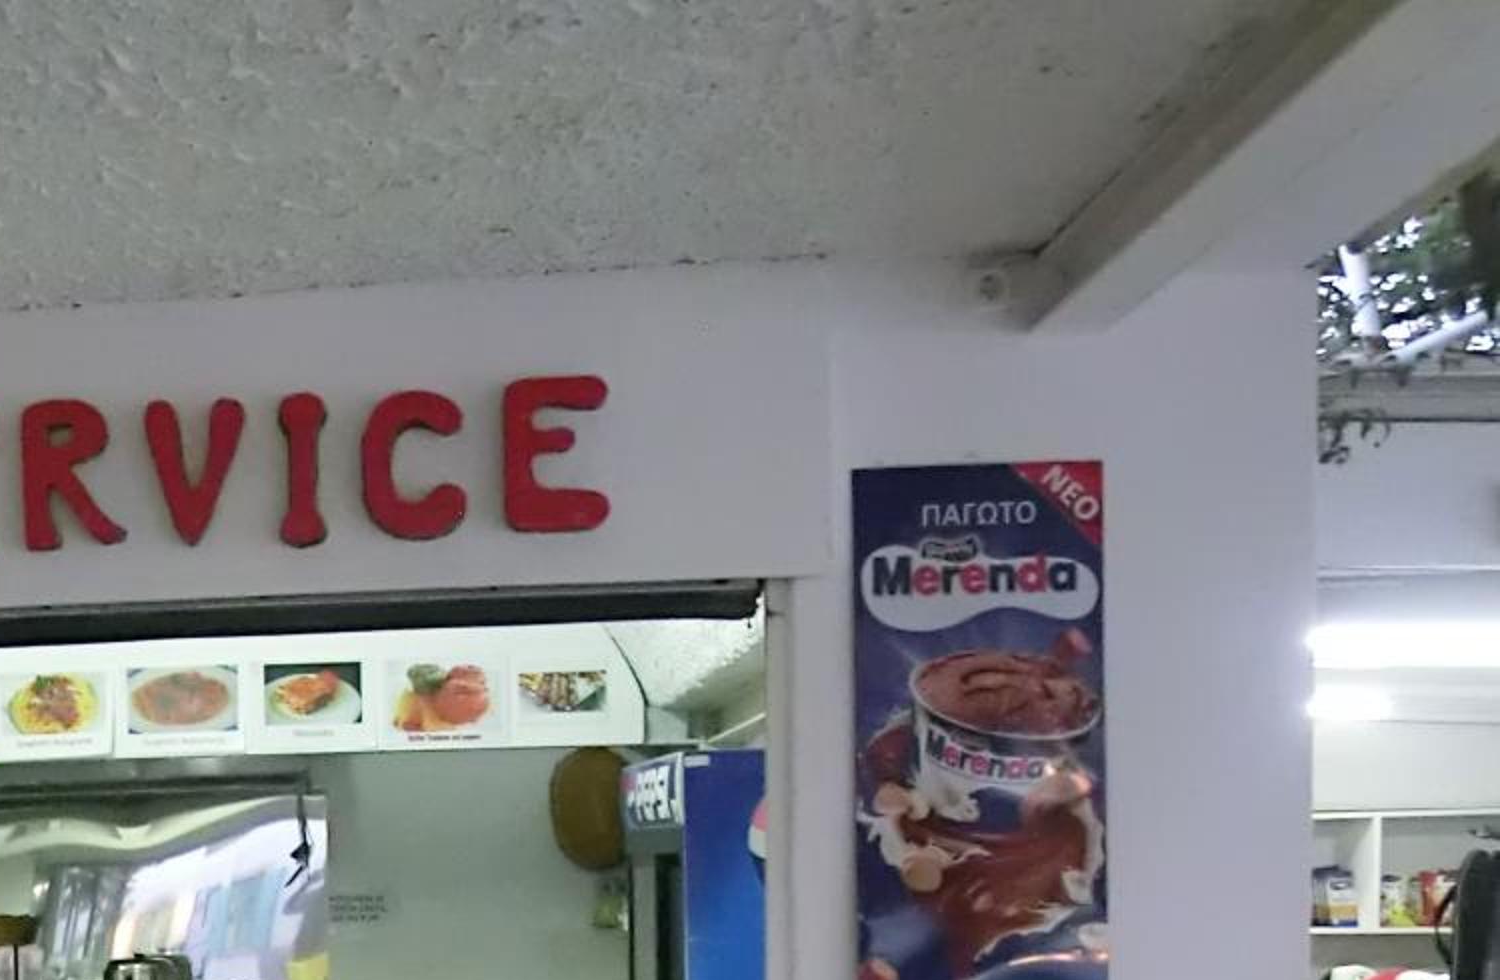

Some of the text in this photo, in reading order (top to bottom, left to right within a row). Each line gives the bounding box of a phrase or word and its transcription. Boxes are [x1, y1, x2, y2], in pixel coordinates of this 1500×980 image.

[921, 501, 1037, 528] ΠΑΓΩΤΟ
[872, 552, 1078, 597] Merenda
[927, 728, 1044, 780] Merenda
